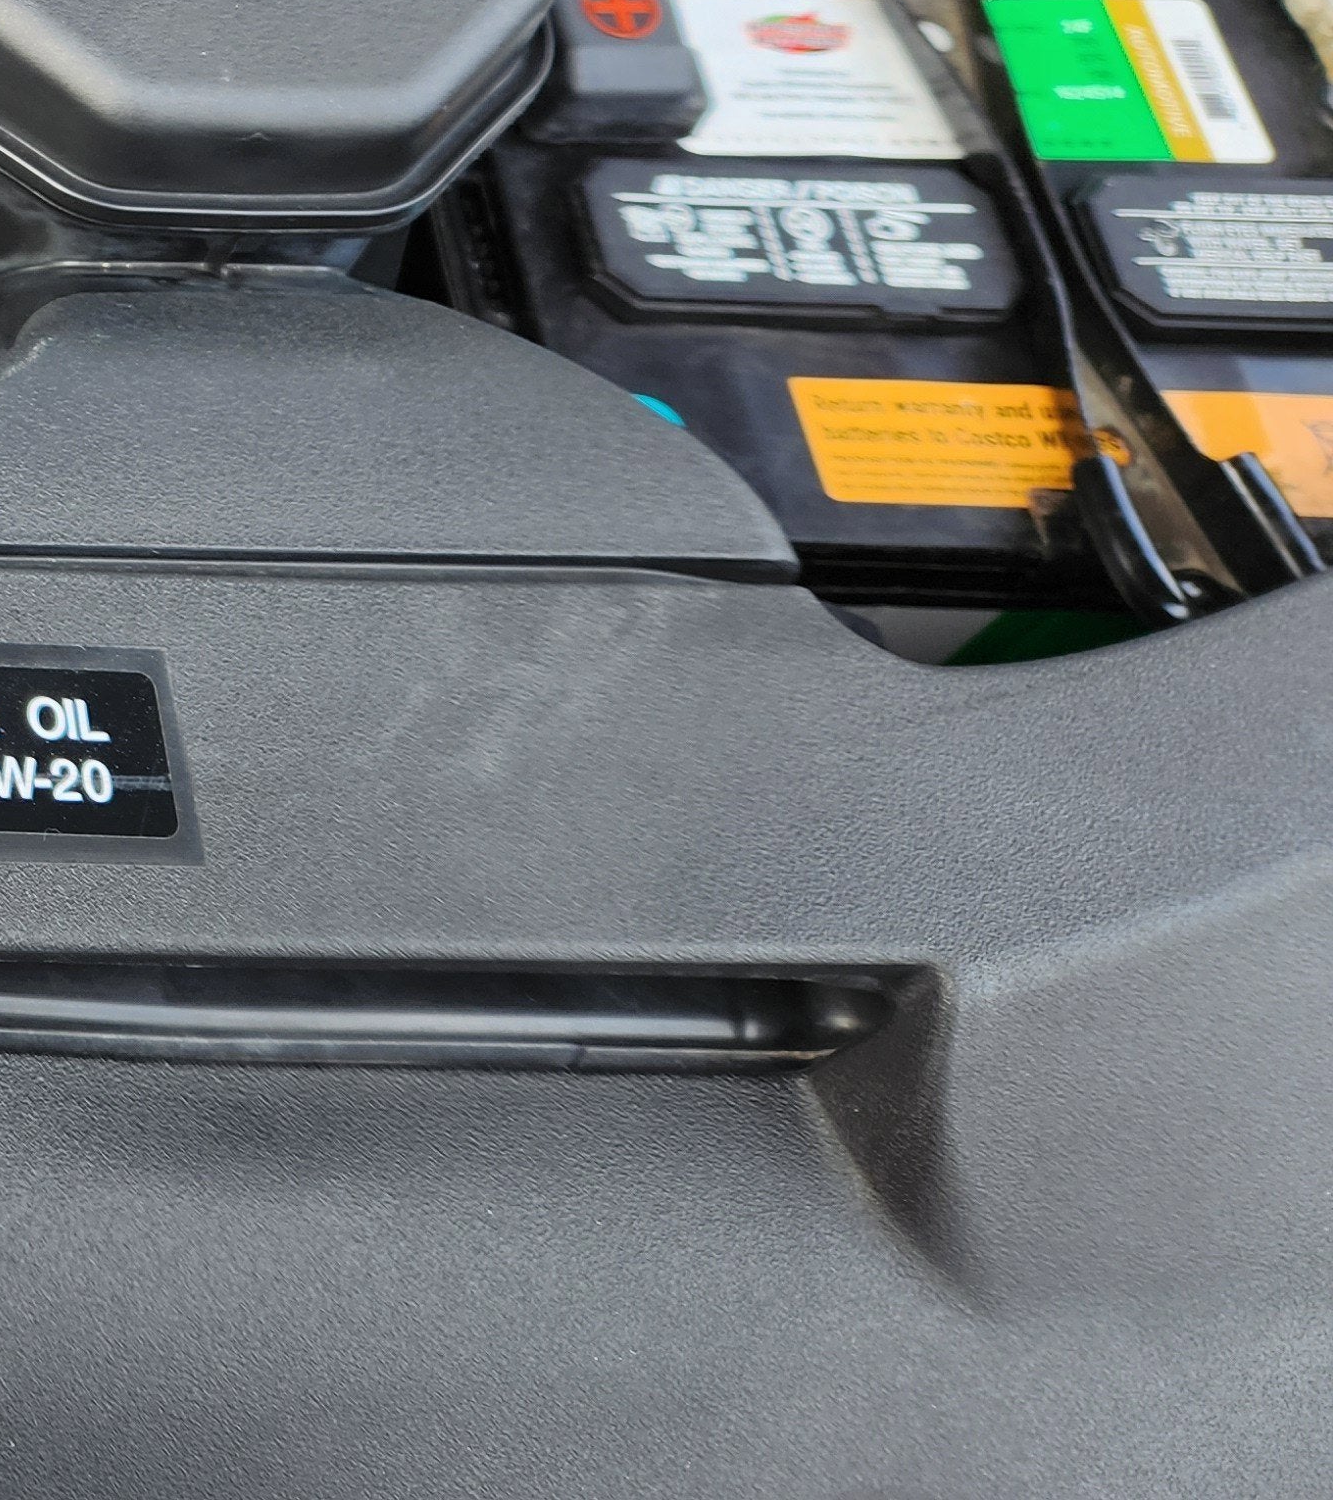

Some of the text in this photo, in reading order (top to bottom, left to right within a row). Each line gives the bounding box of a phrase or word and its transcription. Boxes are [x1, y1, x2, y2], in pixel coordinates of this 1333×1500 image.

[895, 400, 984, 421] warranty
[996, 402, 1034, 421] and
[958, 428, 1032, 449] Costco
[26, 695, 111, 743] OIL
